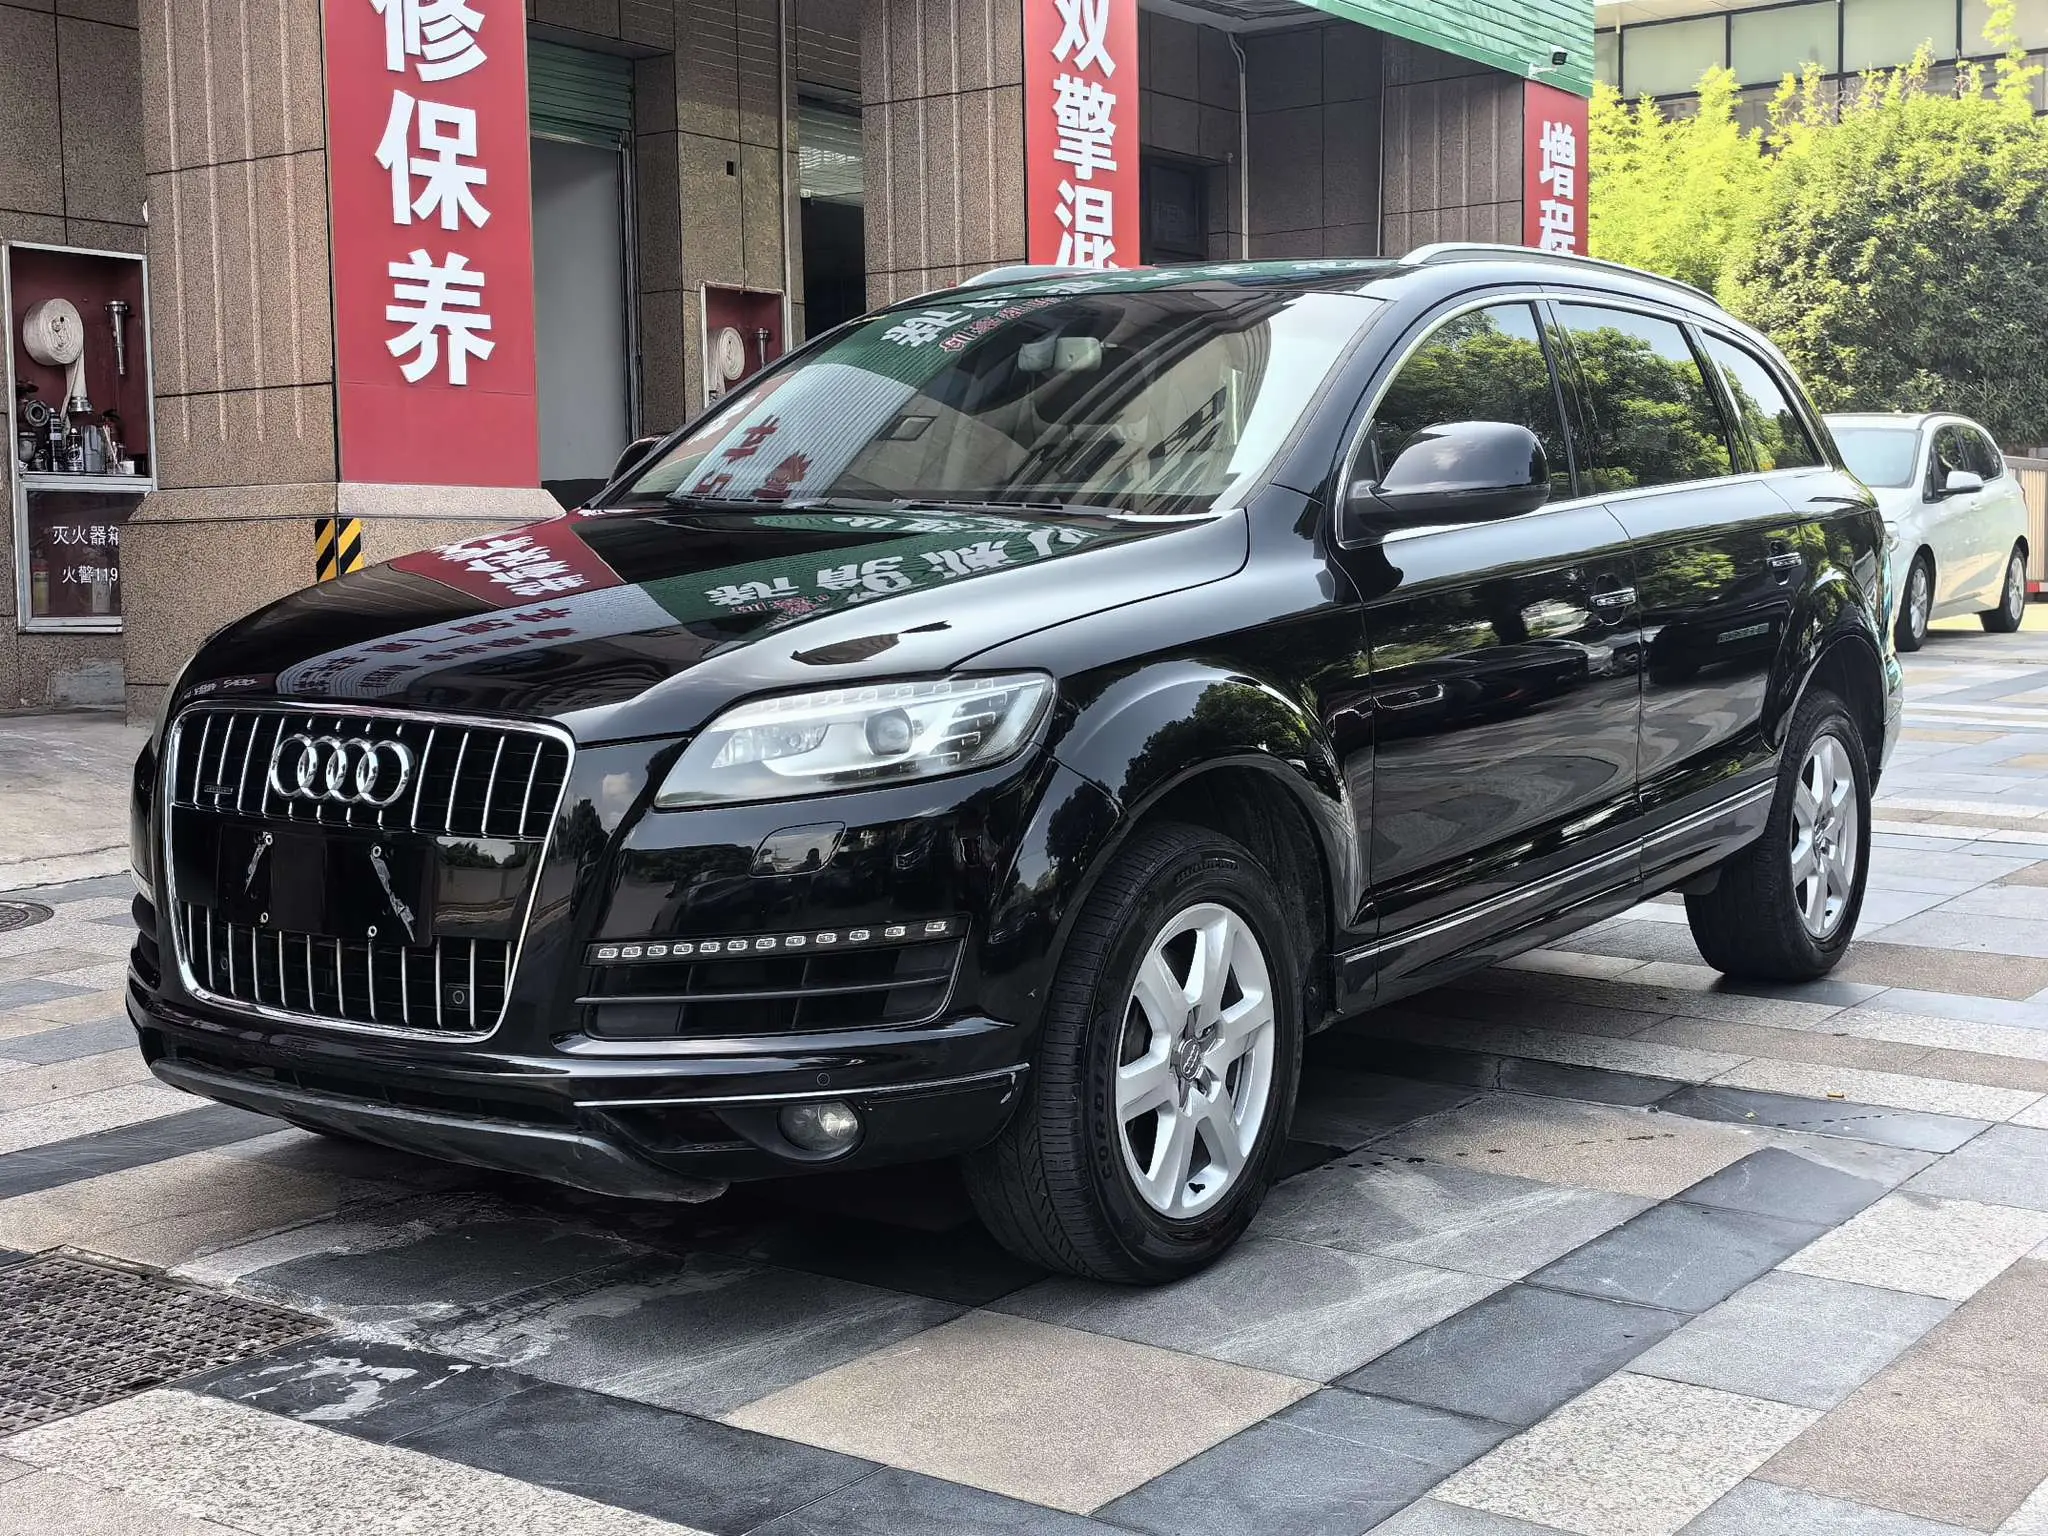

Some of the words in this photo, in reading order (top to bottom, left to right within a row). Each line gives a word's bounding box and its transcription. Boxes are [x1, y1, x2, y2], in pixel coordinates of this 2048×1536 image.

[371, 0, 496, 387] 修保养
[1051, 0, 1118, 268] 双擎混
[1539, 120, 1576, 253] 增程
[62, 565, 118, 584] 火警119
